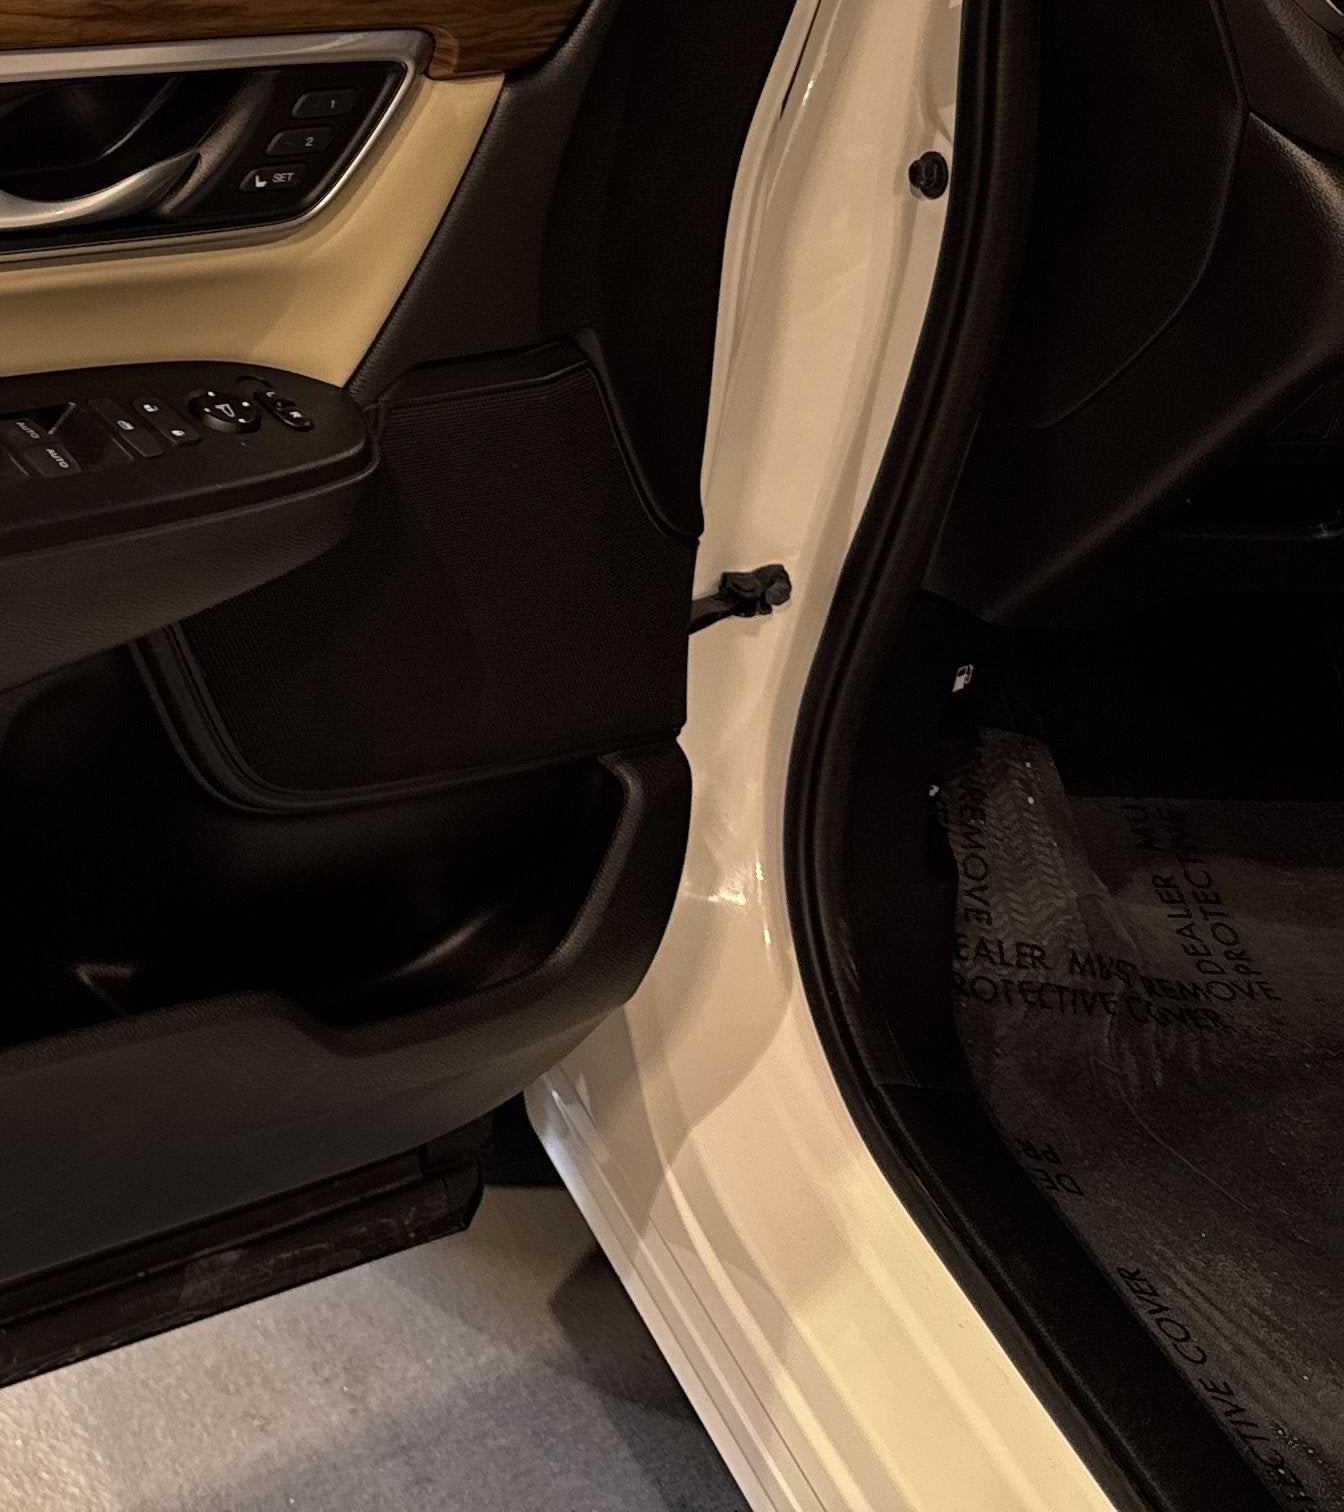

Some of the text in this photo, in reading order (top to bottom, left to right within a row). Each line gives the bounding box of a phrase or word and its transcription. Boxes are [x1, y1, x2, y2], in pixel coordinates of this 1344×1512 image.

[304, 137, 314, 147] 2
[271, 172, 295, 184] SET
[15, 421, 41, 439] AUTO
[46, 448, 69, 468] AUTO
[1123, 804, 1163, 852] MU
[959, 788, 993, 927] REMOVE
[954, 933, 1283, 1002] EALER MUS REMOVE
[952, 972, 1117, 1016] ROTECTIVE
[1116, 1266, 1208, 1366] COVER
